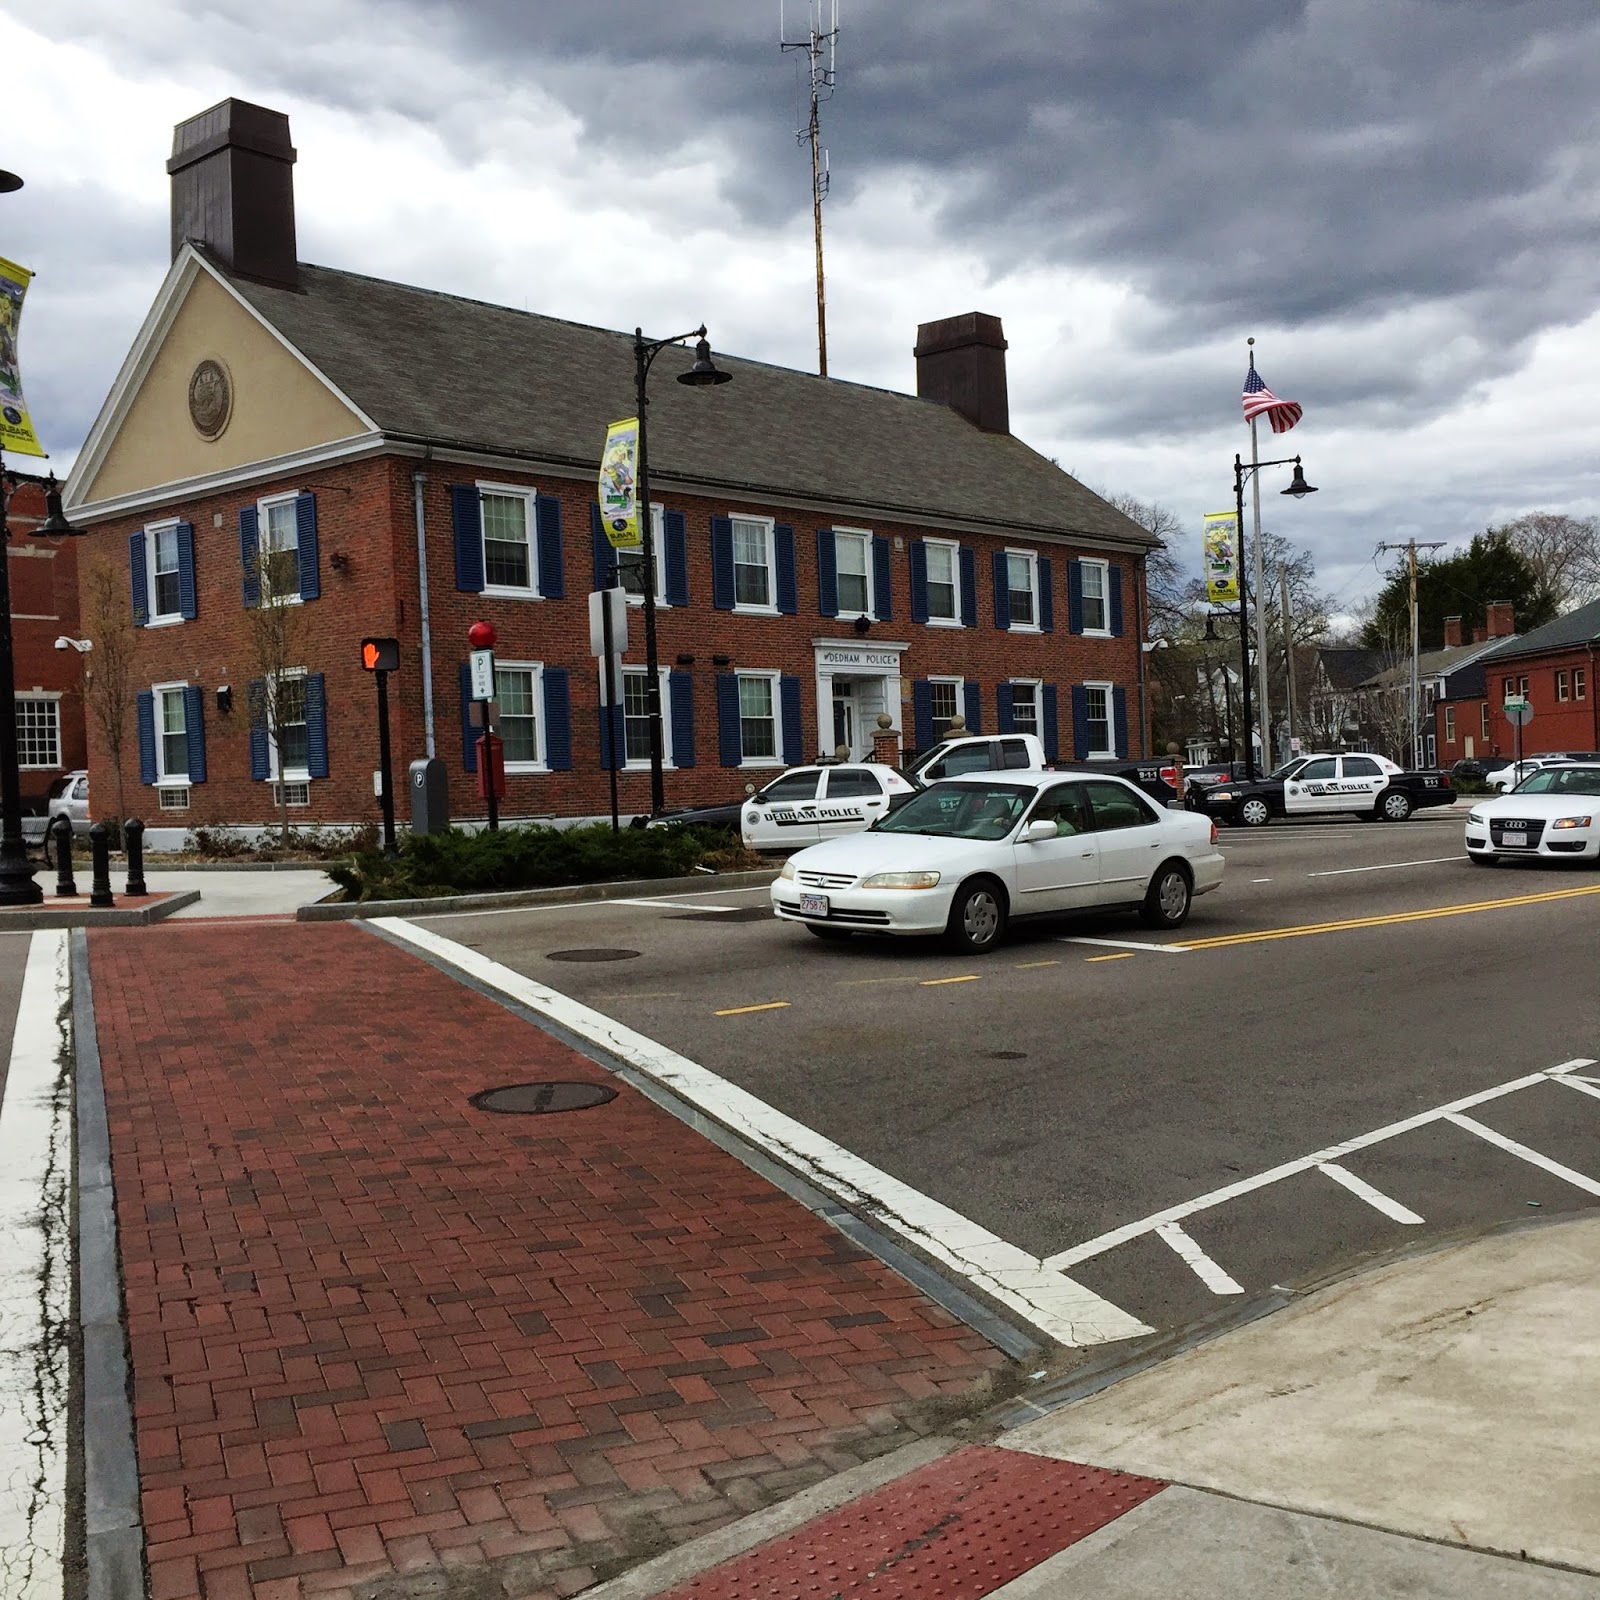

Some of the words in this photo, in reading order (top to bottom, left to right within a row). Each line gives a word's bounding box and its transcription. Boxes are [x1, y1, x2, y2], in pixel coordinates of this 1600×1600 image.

[829, 653, 860, 664] DEDHAM
[866, 654, 892, 665] POLICE
[416, 774, 423, 785] P
[1341, 783, 1371, 791] POLICE
[764, 811, 817, 822] DEDHAM
[820, 807, 863, 818] POLICE
